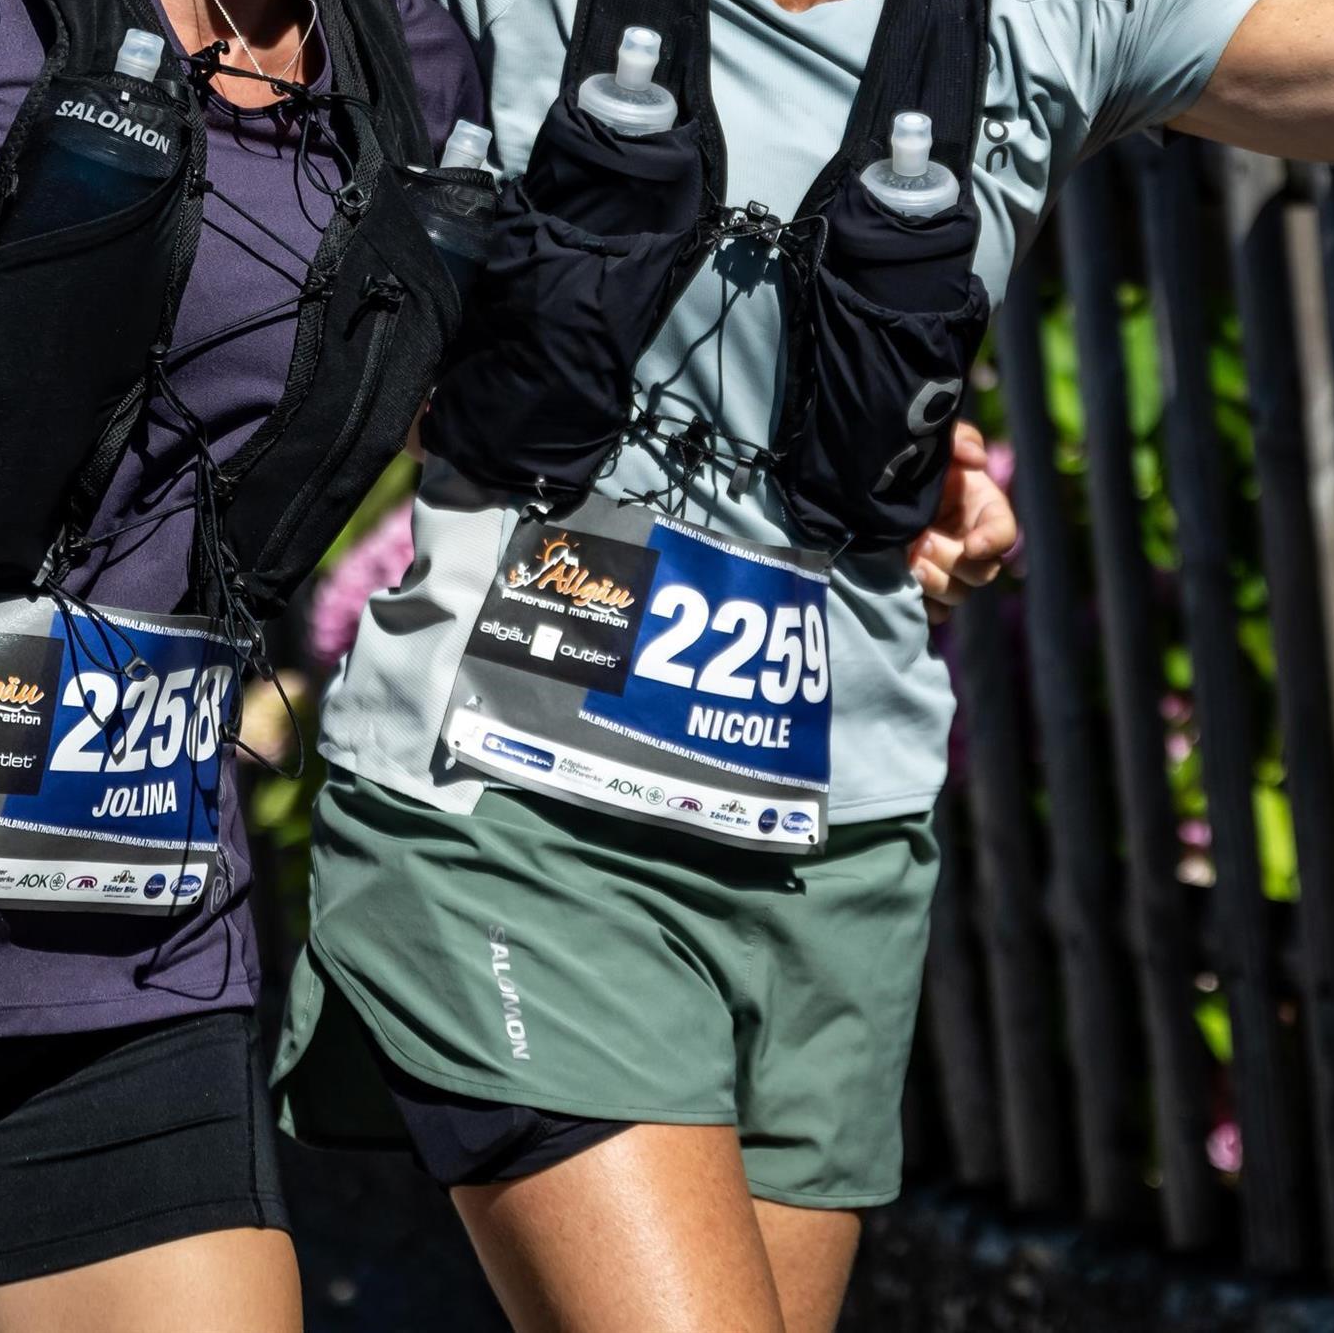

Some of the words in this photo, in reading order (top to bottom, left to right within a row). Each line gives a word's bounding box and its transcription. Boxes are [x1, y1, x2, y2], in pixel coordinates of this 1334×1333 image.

[55, 100, 170, 154] SALOMON
[537, 563, 635, 609] Allgäu
[502, 588, 566, 614] panorama
[568, 608, 629, 630] marathon
[480, 621, 532, 645] allgäu
[634, 584, 829, 705] 2259
[49, 665, 234, 772] 2258
[687, 706, 792, 749] NICOLE
[485, 737, 552, 767] Champion
[91, 781, 178, 818] JOLINA
[606, 778, 644, 799] AOK
[15, 873, 51, 889] AOK
[488, 924, 531, 1060] SALOMON
